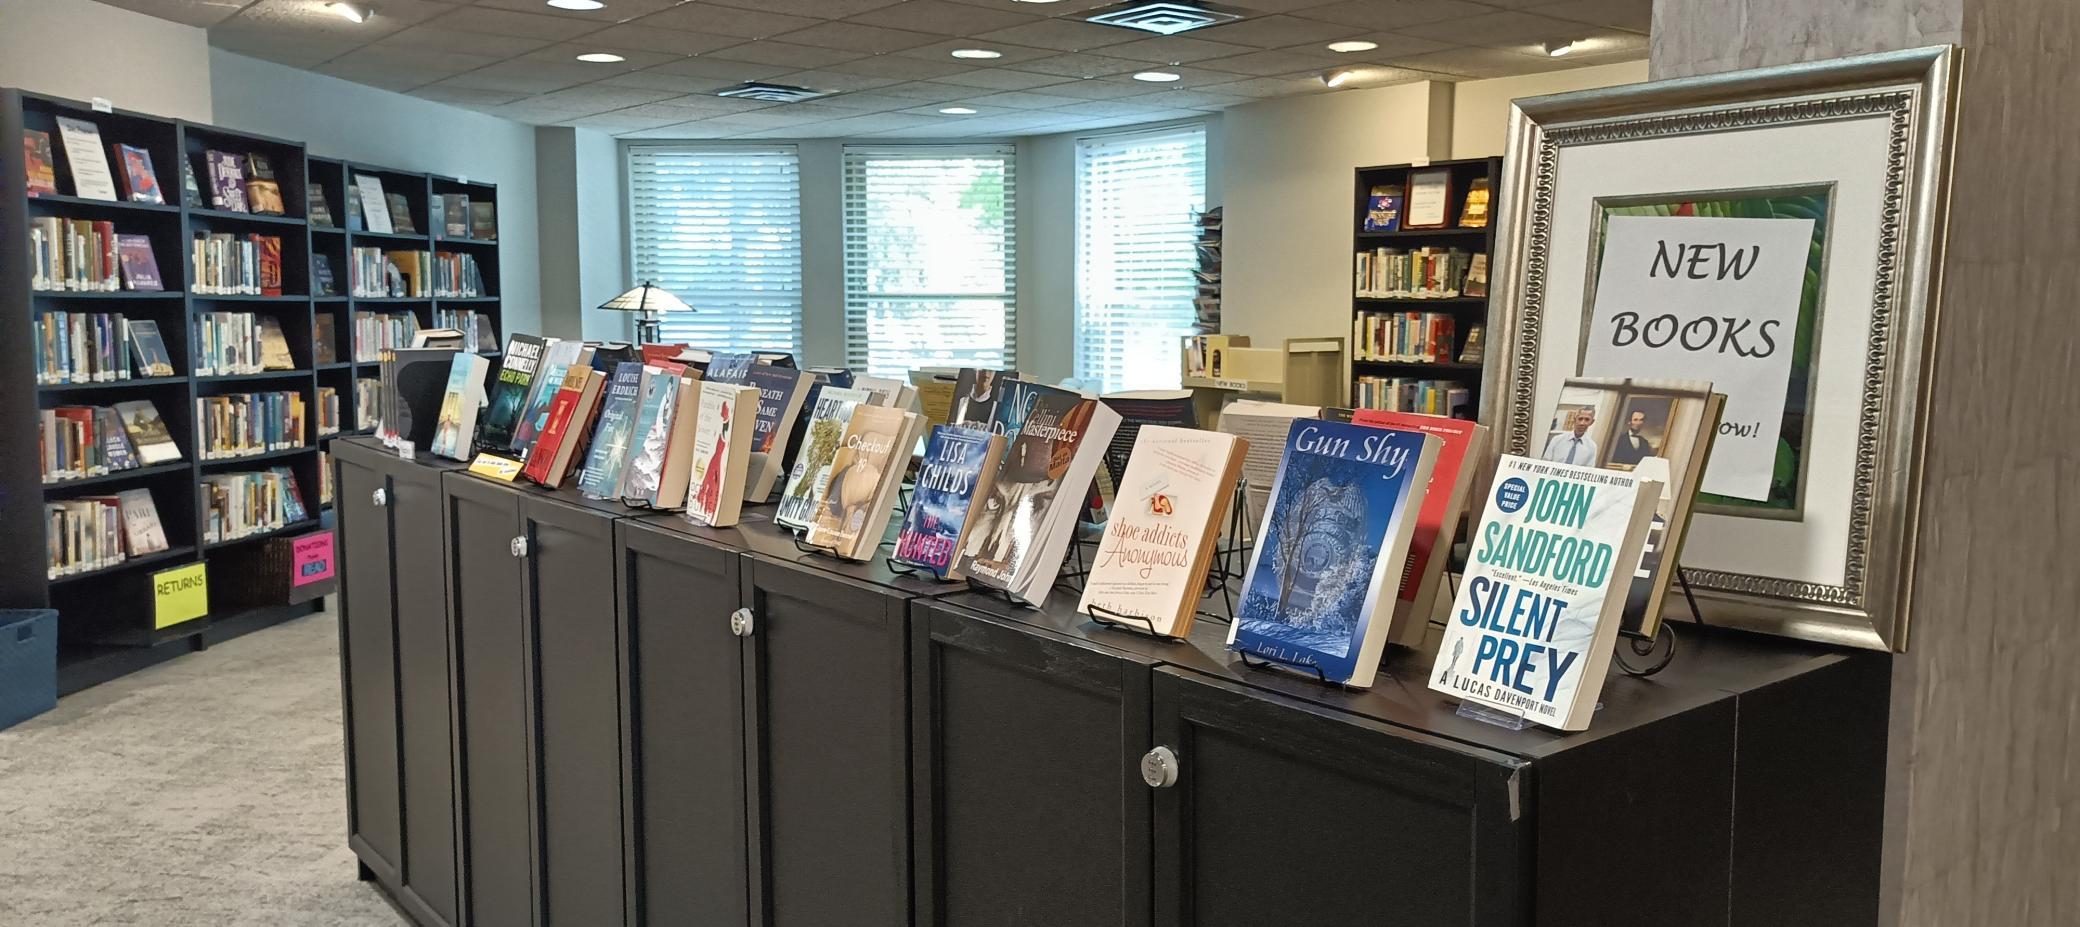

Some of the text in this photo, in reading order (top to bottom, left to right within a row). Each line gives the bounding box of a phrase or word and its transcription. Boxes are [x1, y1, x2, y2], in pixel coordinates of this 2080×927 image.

[1649, 240, 1760, 281] NEW
[1611, 311, 1780, 358] BOOKS
[509, 339, 540, 359] MICHAEL
[503, 355, 538, 373] CONNELLY
[500, 369, 516, 383] ECHO
[515, 373, 532, 387] PARK
[619, 373, 640, 384] LOUISE
[611, 384, 639, 397] ERDRICH
[756, 400, 778, 418] SAME
[1028, 408, 1057, 427] Cellini
[1021, 420, 1078, 444] Masterpiece
[1718, 422, 1760, 438] ow!
[847, 434, 890, 454] Checkout
[940, 440, 968, 465] LISA
[1295, 426, 1350, 458] Gun
[1356, 432, 1410, 480] Shy
[921, 463, 973, 496] CHILDS
[1508, 460, 1634, 488] #1 NEW YORK TIMES BESTSELLING AUTHOR
[1503, 482, 1526, 493] SPECIAL
[1504, 492, 1521, 501] VALUE
[1501, 500, 1518, 510] PRICE
[1524, 477, 1596, 530] JOHN
[923, 514, 940, 529] THE
[1111, 517, 1189, 549] shoe addicts
[1100, 533, 1189, 580] Anonymous
[1477, 521, 1613, 589] SANDFORD
[970, 560, 999, 578] Raymond
[157, 574, 203, 596] RETURNS
[1491, 568, 1523, 583] "Excellent."
[1540, 580, 1561, 593] Angeles
[1561, 583, 1579, 596] Times
[1460, 576, 1569, 643] SILENT
[1257, 641, 1278, 656] Lori
[1472, 634, 1579, 703] PREY
[1439, 670, 1557, 718] A LUCAS DAVENPORT NOVEL
